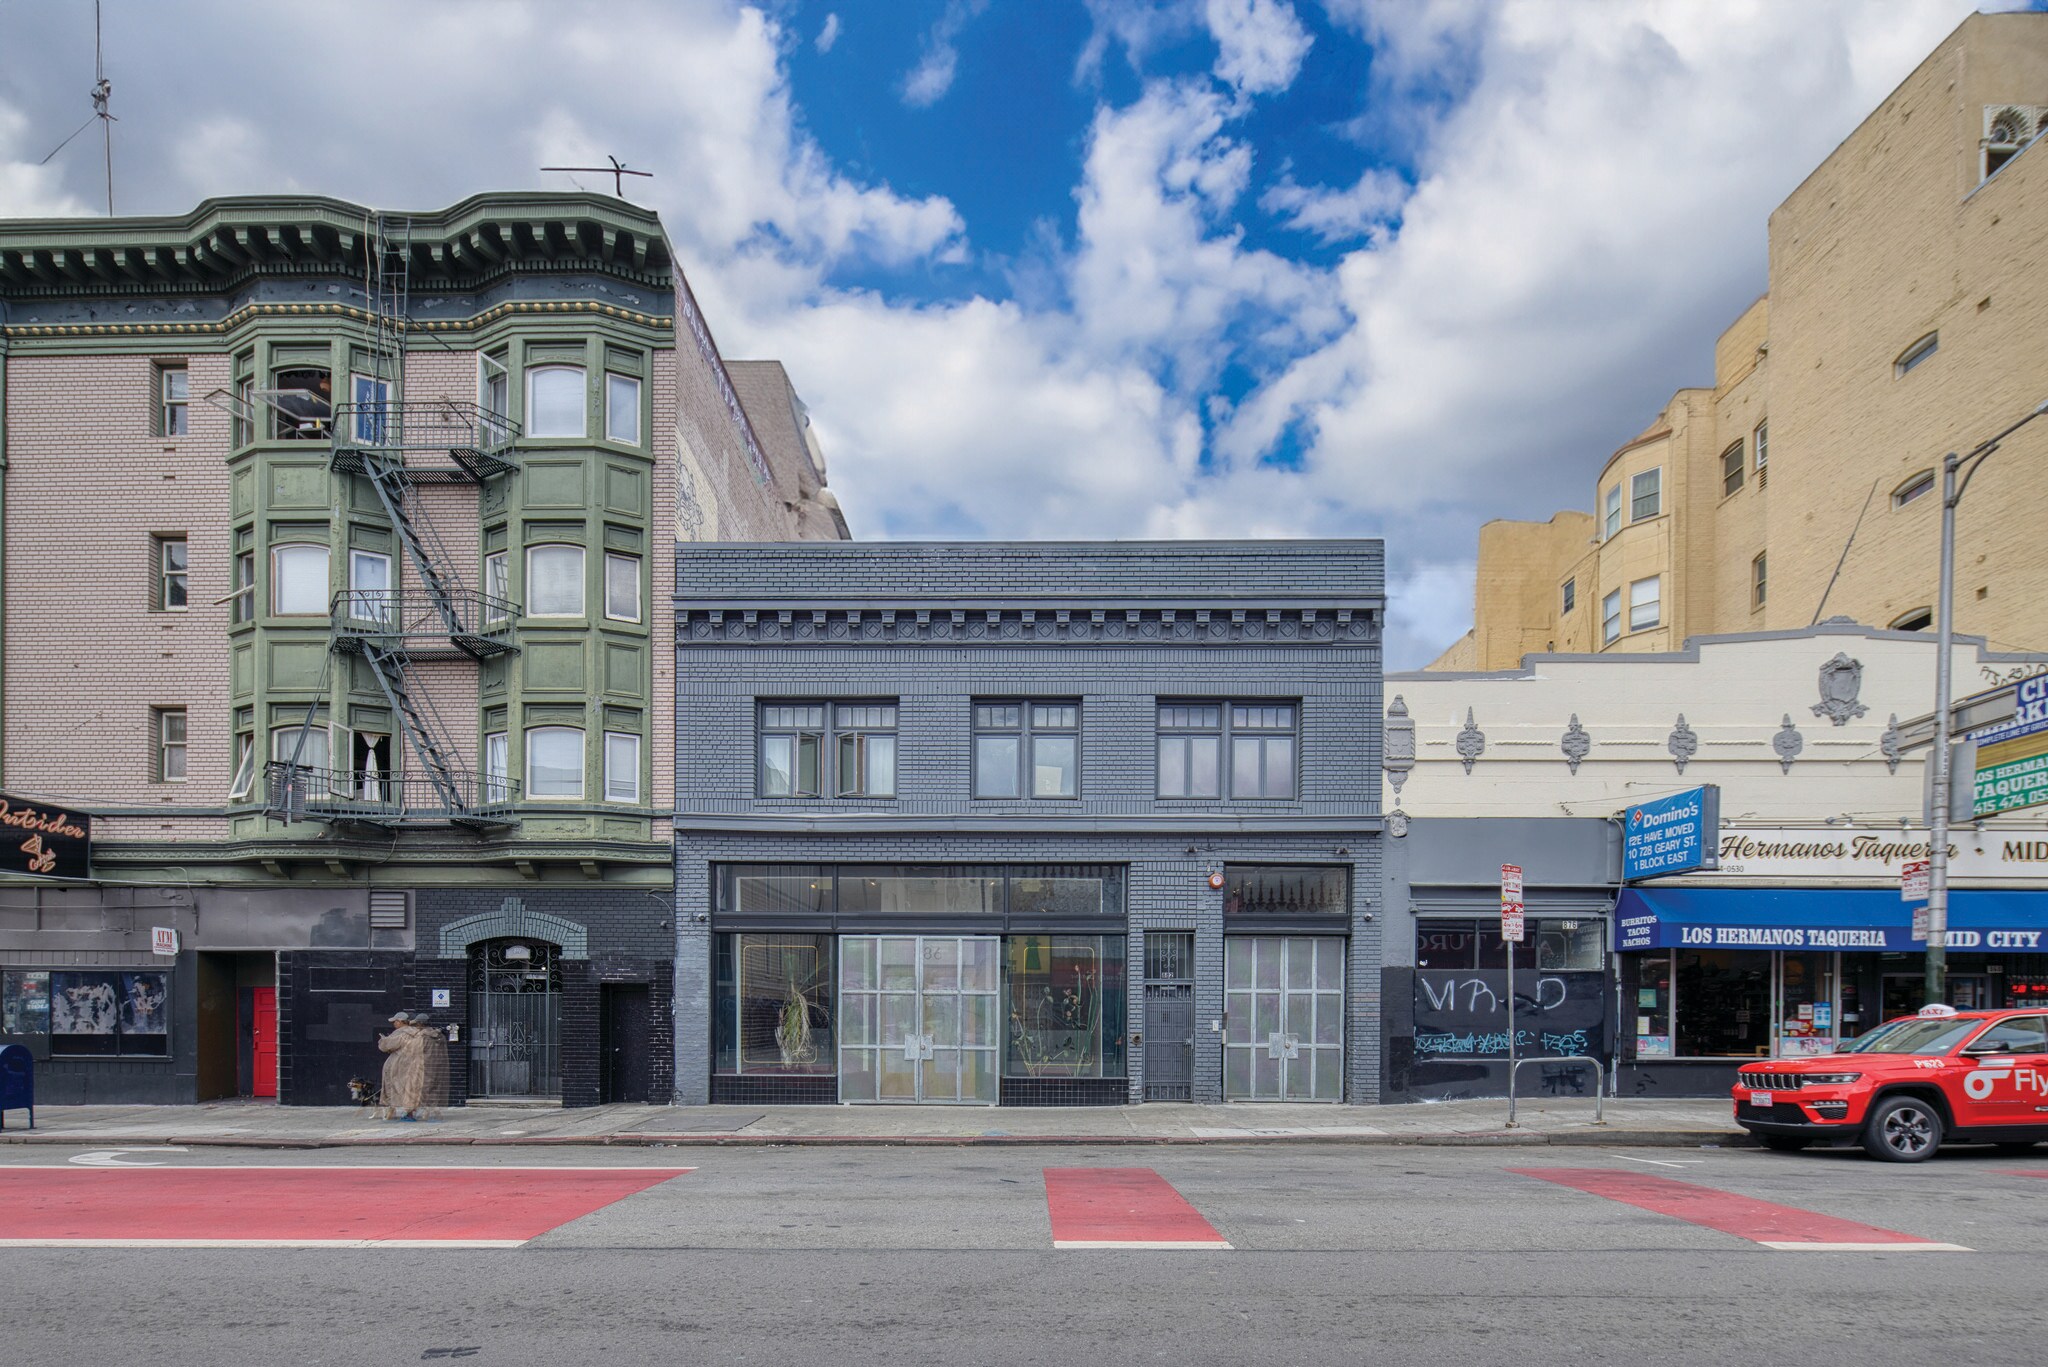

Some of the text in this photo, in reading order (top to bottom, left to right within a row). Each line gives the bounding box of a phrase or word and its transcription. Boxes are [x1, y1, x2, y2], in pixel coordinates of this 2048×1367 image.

[1973, 800, 1996, 814] 415
[1999, 793, 2025, 808] 474
[1643, 801, 1698, 828] Domino's
[1644, 829, 1663, 843] HAVE
[1665, 822, 1695, 839] MOVED
[1639, 845, 1653, 857] 728
[1654, 838, 1682, 854] GEARY
[1683, 835, 1697, 848] ST.
[1718, 834, 1847, 860] Hermanos
[1634, 850, 1688, 870] 1 BLOCK EAST
[1563, 921, 1577, 929] 876
[1621, 915, 1657, 927] BURRITOS
[157, 930, 173, 943] ATM
[1622, 936, 1651, 947] NACHOS
[1627, 926, 1650, 937] TACOS
[1682, 927, 1712, 944] LOS
[1716, 929, 1804, 946] HERMANOS
[1807, 930, 1887, 947] TAQUERIA
[1986, 930, 2042, 948] CITY
[1921, 1008, 1944, 1016] TAXI
